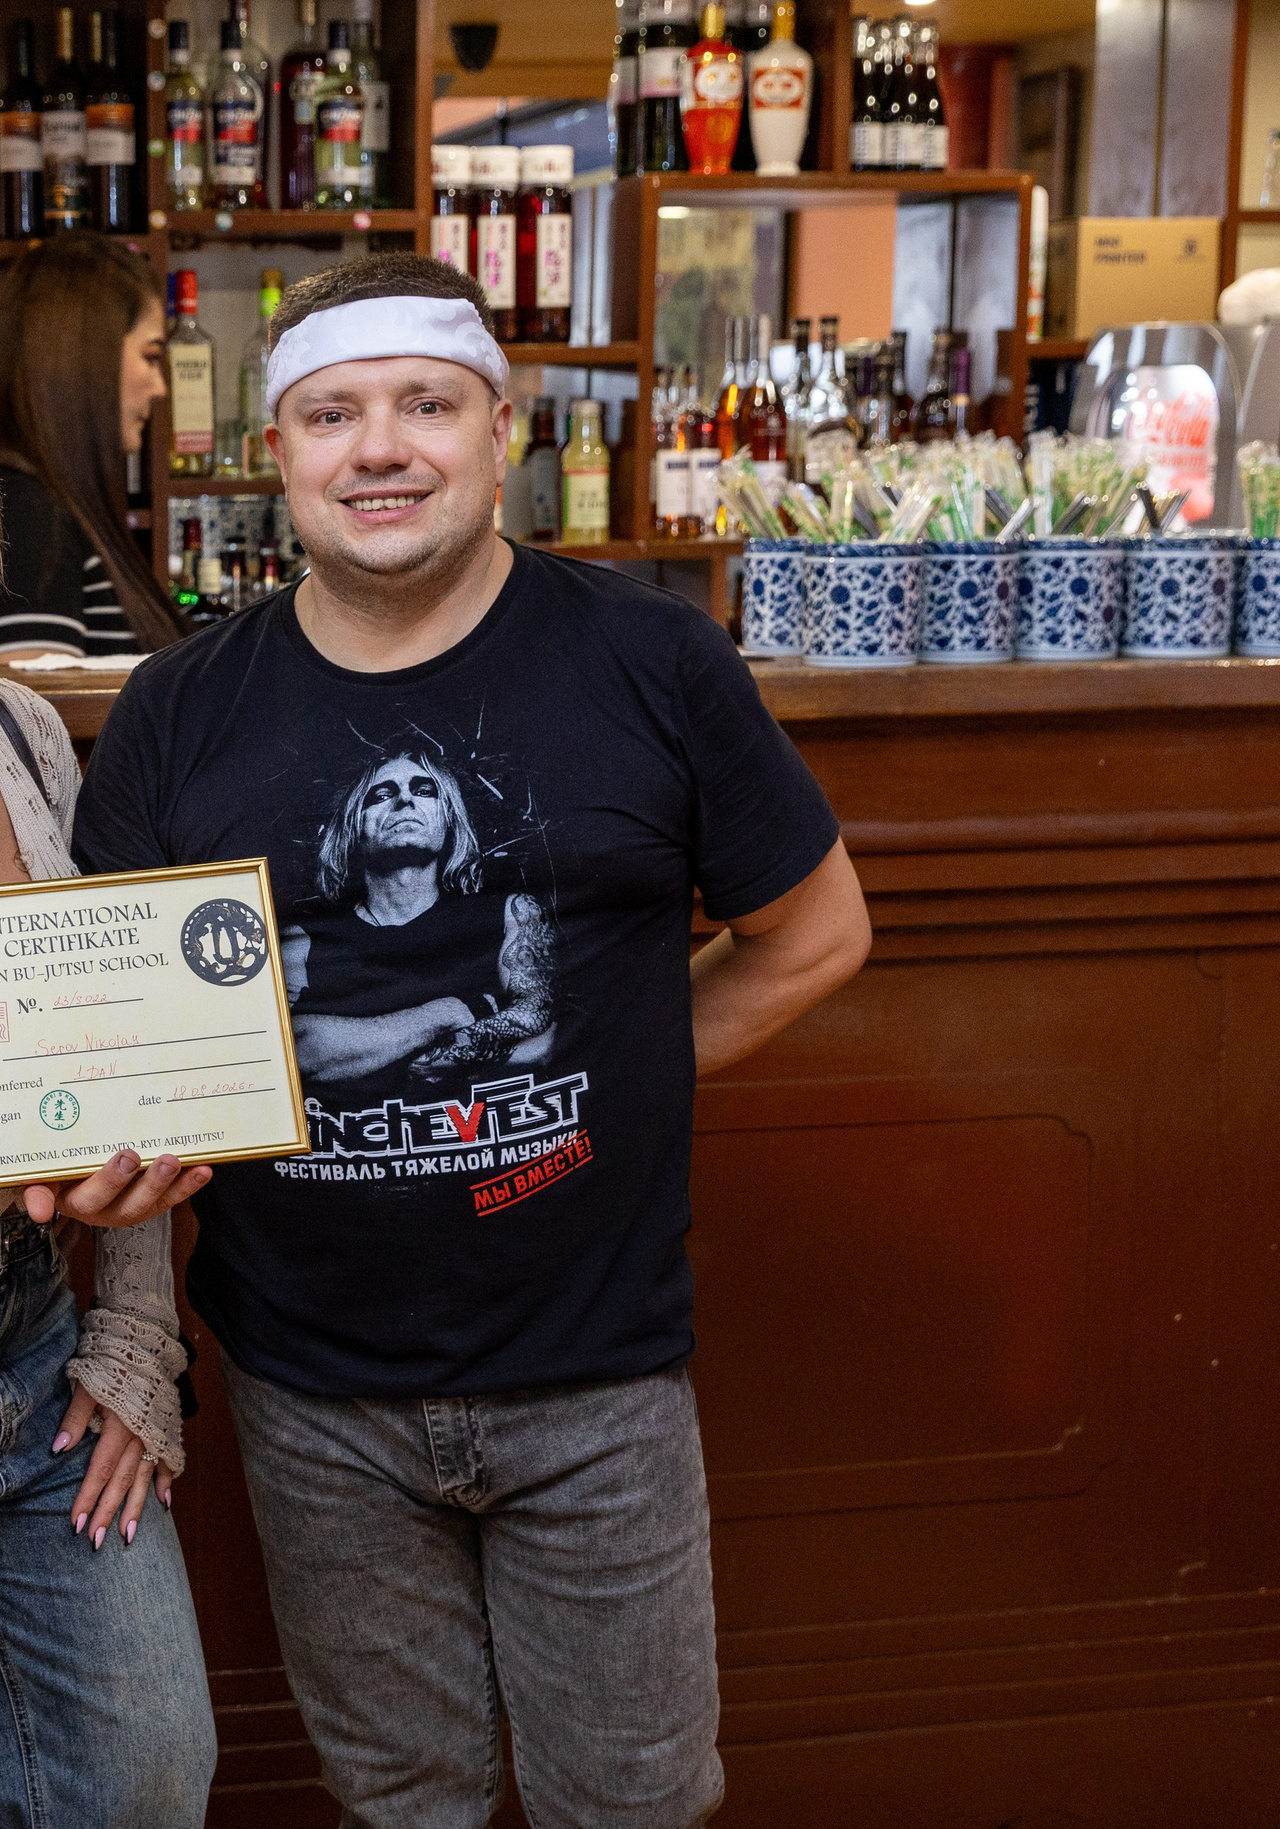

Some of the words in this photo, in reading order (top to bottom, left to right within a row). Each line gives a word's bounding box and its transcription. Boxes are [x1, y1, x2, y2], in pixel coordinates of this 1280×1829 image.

[4, 927, 140, 957] CERTIFIKATE
[14, 960, 94, 982] BU-JUTSU
[99, 953, 169, 974] SCHOOL
[41, 1093, 56, 1114] SENSEI
[64, 1094, 77, 1115] KOGAN
[138, 1095, 162, 1106] date
[62, 1145, 100, 1158] CENTRE
[103, 1139, 162, 1152] DAITO-RYU
[164, 1132, 225, 1146] AIKIJUJUTSU
[274, 1161, 386, 1181] ФЕСТИВАЛЬ
[391, 1148, 495, 1178] ТЯЖЕЛОЙ
[500, 1129, 578, 1166] МУЗЫКИ
[474, 1186, 512, 1210] МЫ
[513, 1136, 593, 1194] ВМЕСТЕ!
